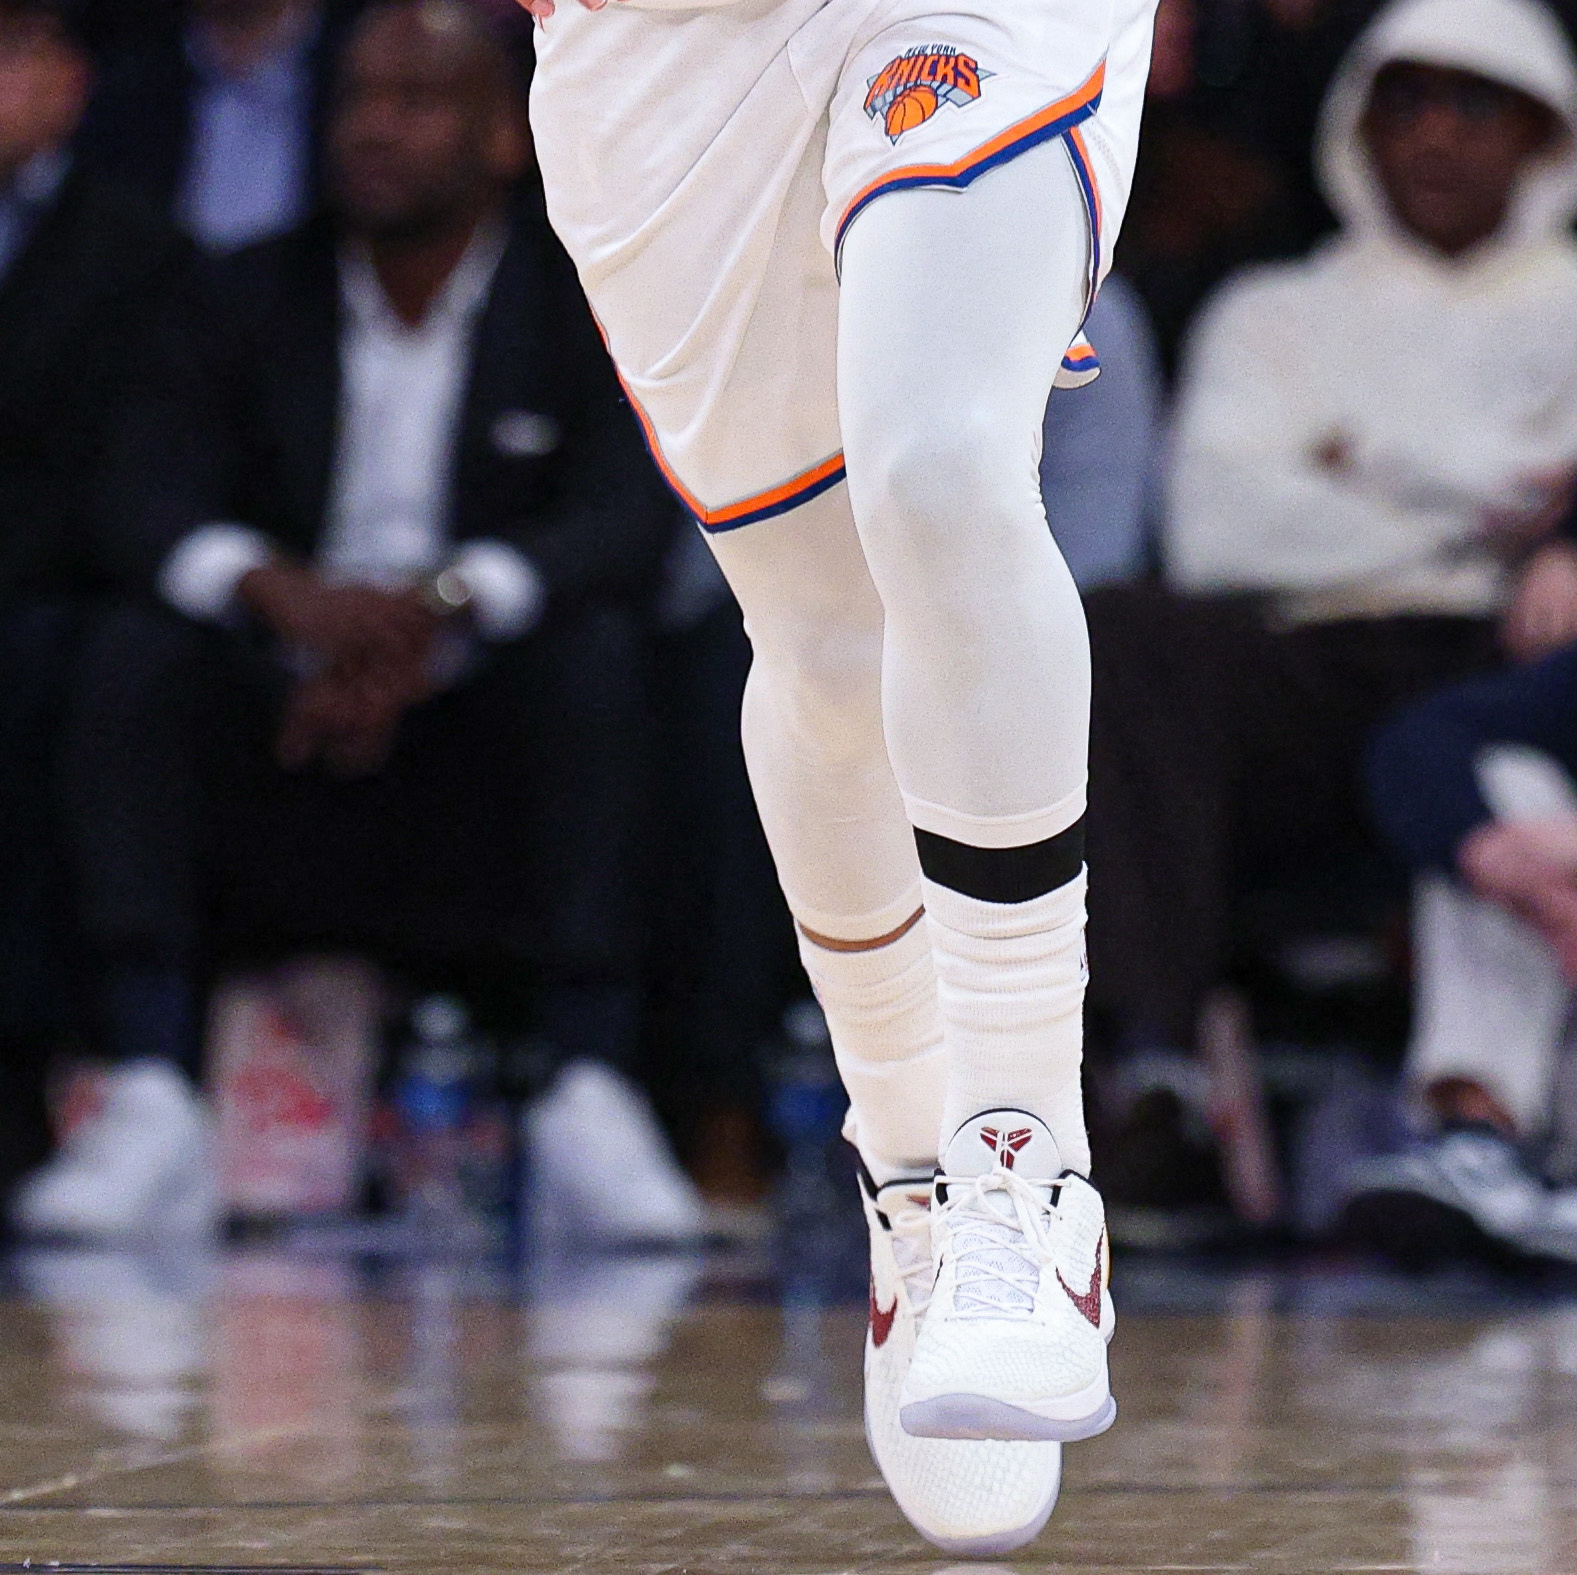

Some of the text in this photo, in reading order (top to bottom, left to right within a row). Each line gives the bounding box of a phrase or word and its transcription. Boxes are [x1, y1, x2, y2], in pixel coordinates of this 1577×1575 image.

[904, 43, 956, 59] NEW YORK
[864, 53, 981, 110] KNICKS
